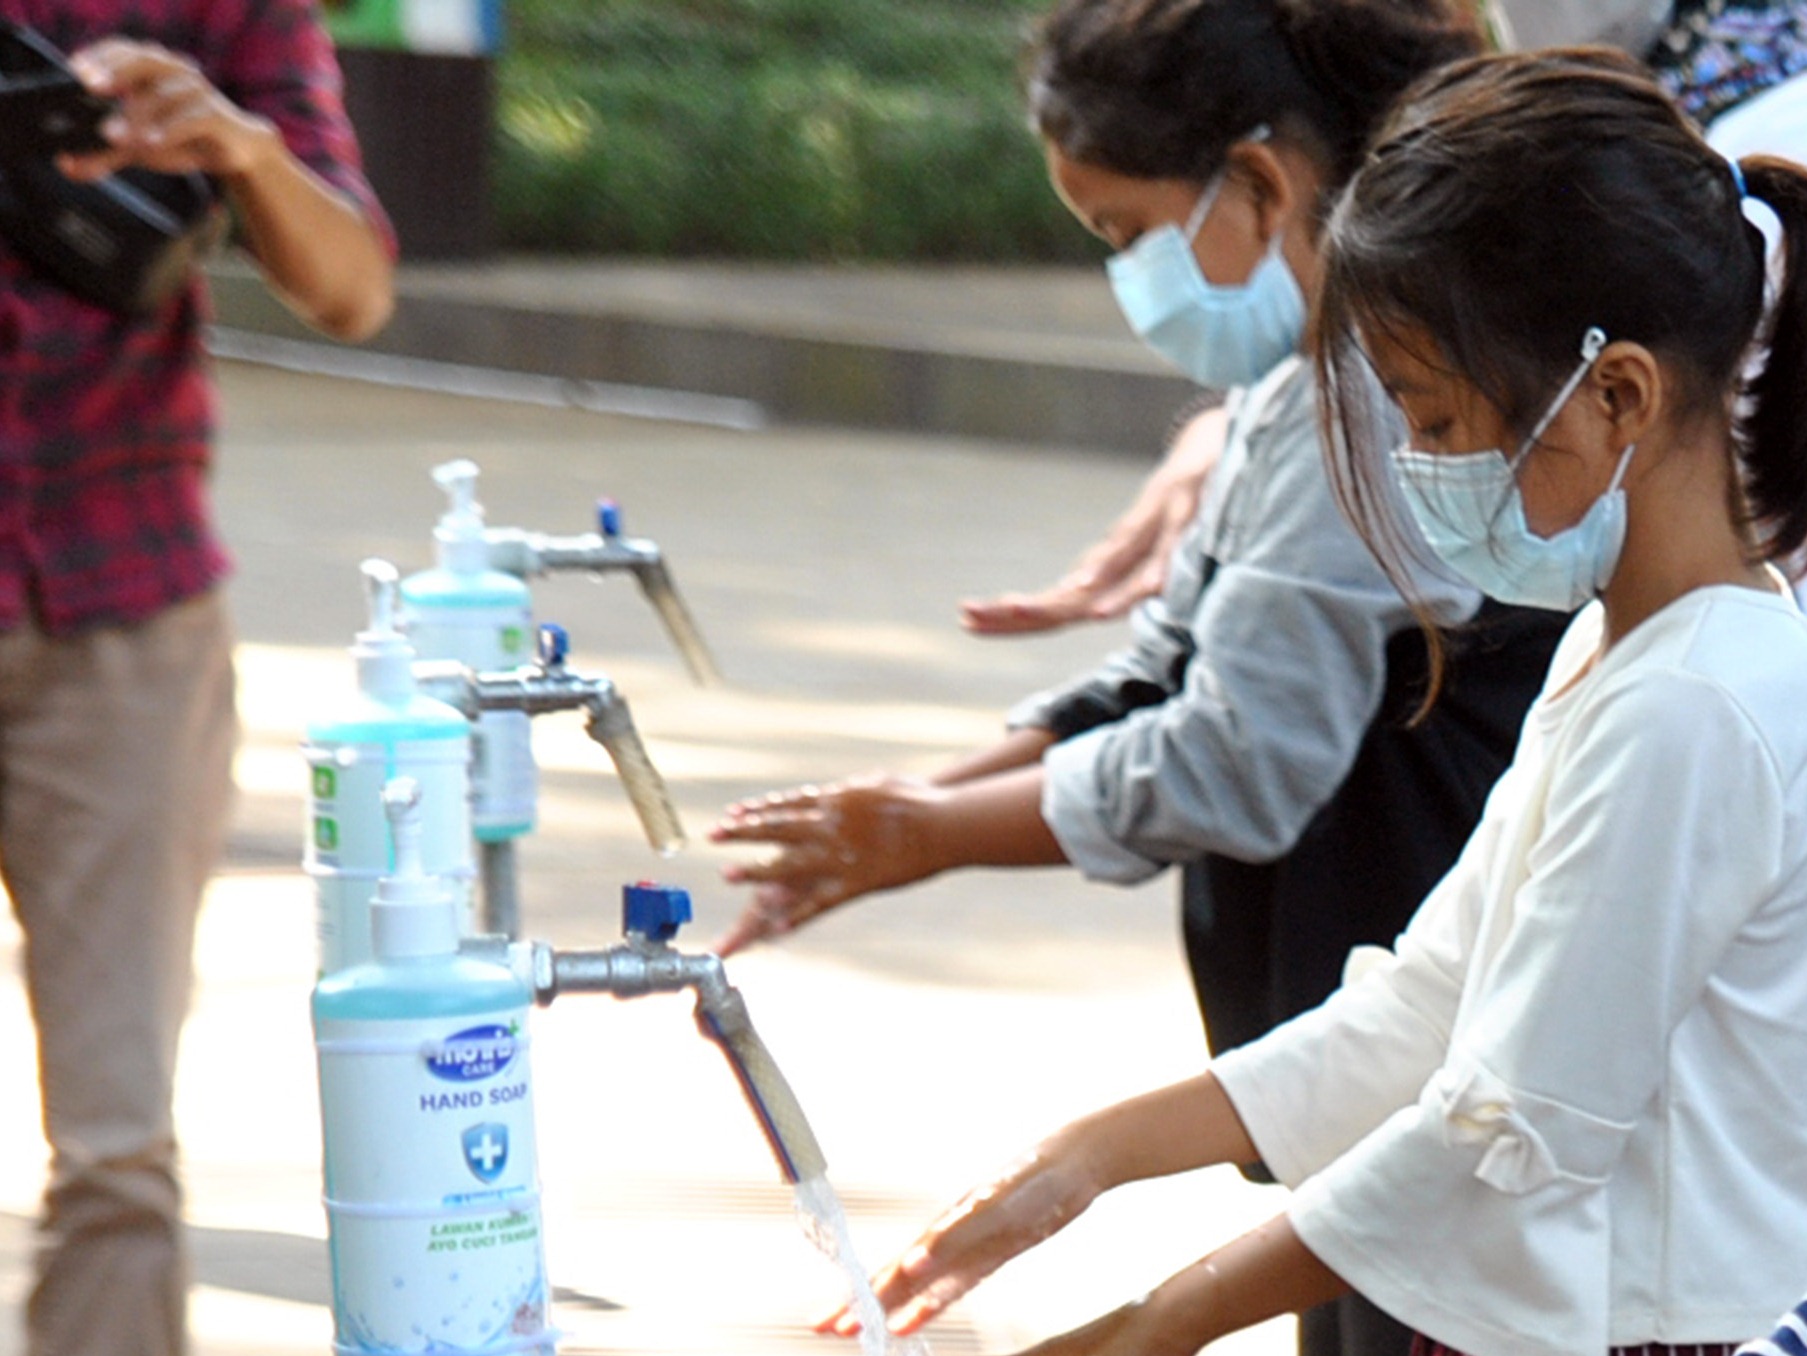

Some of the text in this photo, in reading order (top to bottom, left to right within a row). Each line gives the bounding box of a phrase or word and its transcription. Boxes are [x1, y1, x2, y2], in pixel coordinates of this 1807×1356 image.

[461, 1061, 495, 1077] CARE
[419, 1083, 528, 1112] HAND SOAP
[426, 1239, 458, 1253] AYO
[461, 1235, 496, 1250] CUCI
